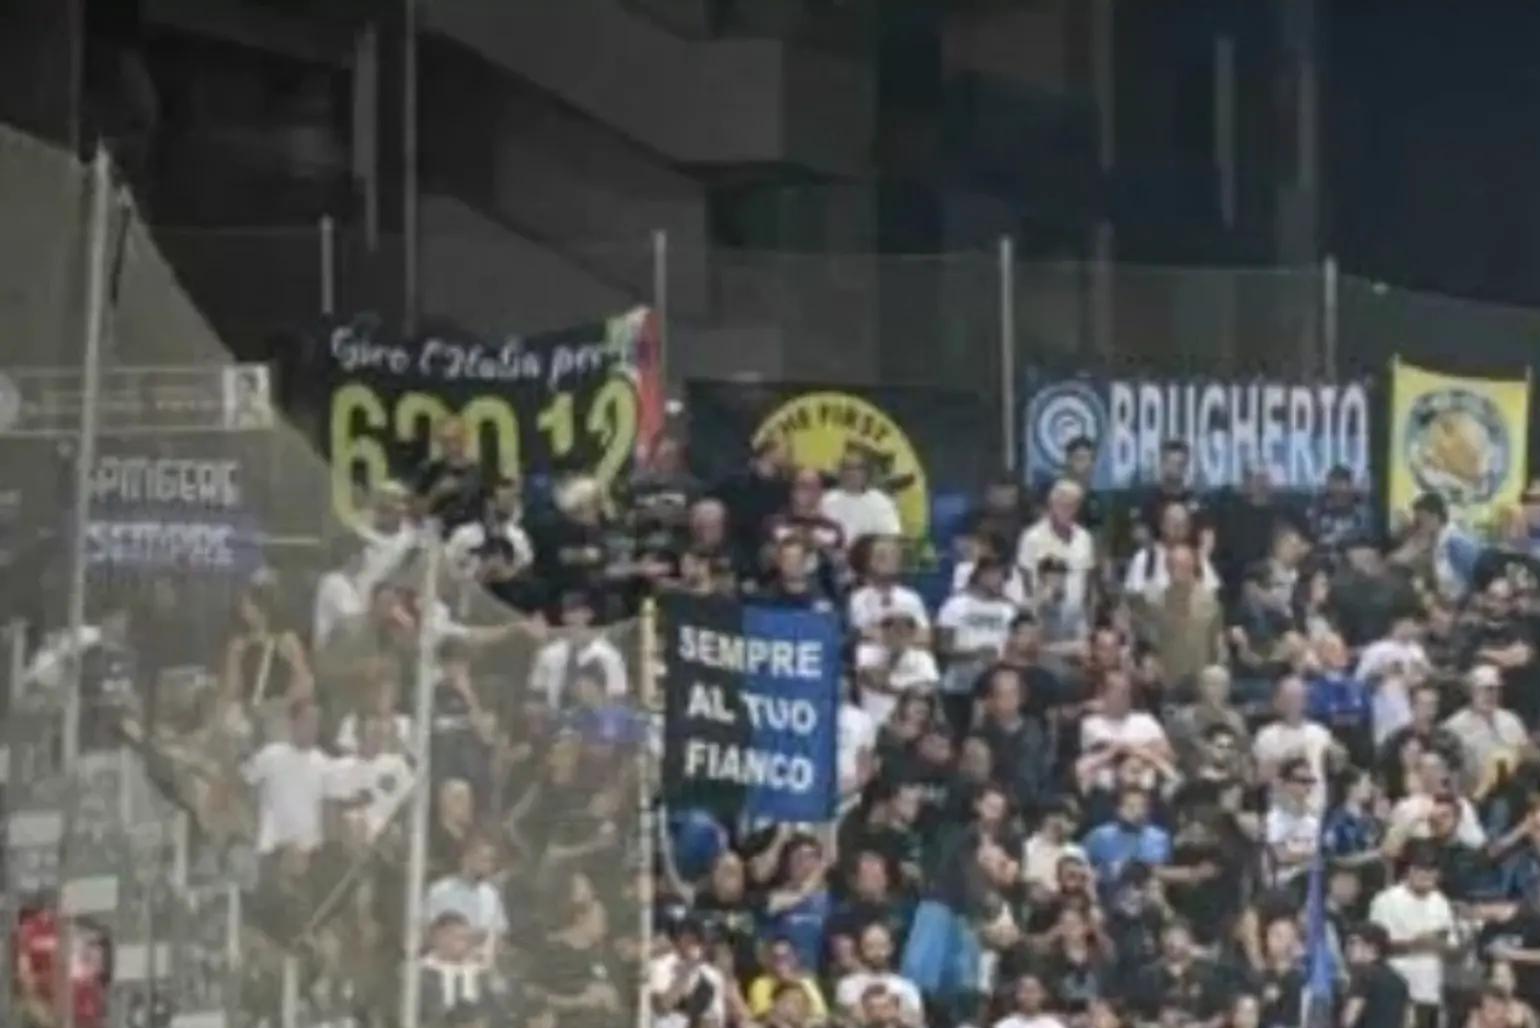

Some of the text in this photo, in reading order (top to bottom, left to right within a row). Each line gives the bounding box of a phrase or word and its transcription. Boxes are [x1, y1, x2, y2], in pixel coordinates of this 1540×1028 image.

[678, 623, 824, 680] SEMPRE
[686, 683, 819, 735] AL TUO
[683, 738, 816, 794] FIANCO
